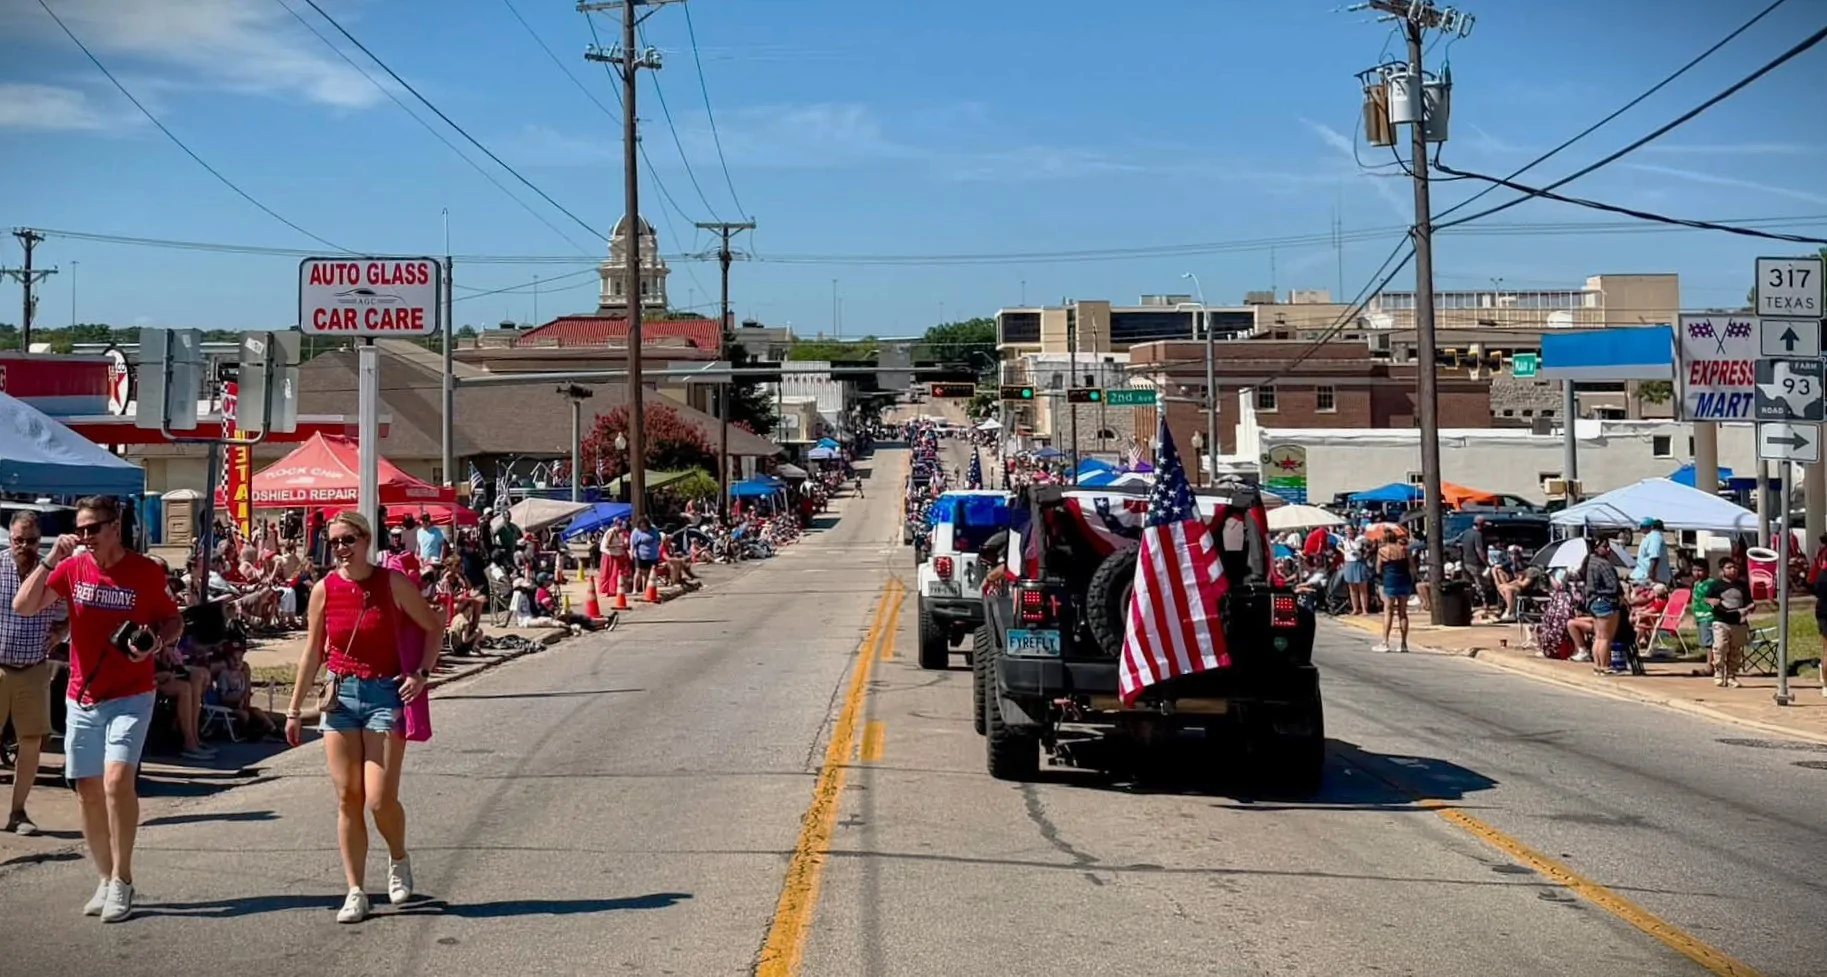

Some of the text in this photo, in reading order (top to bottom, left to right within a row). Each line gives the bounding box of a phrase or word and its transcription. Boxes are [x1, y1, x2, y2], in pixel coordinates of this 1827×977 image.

[309, 262, 429, 285] AUTO GLASS
[1769, 268, 1811, 288] 317
[1764, 296, 1814, 309] TEXAS
[313, 307, 424, 330] CAR CARE
[1794, 362, 1817, 370] FARM
[1782, 377, 1811, 395] 93
[1110, 392, 1133, 403] 2nd
[1694, 392, 1754, 418] MART
[1761, 406, 1784, 414] ROAD
[265, 466, 307, 479] ROCK
[252, 488, 358, 501] DSHIELD REPAIR
[76, 585, 94, 601] RED
[95, 588, 132, 606] FRIDAY
[1010, 636, 1055, 650] FYREFLY
